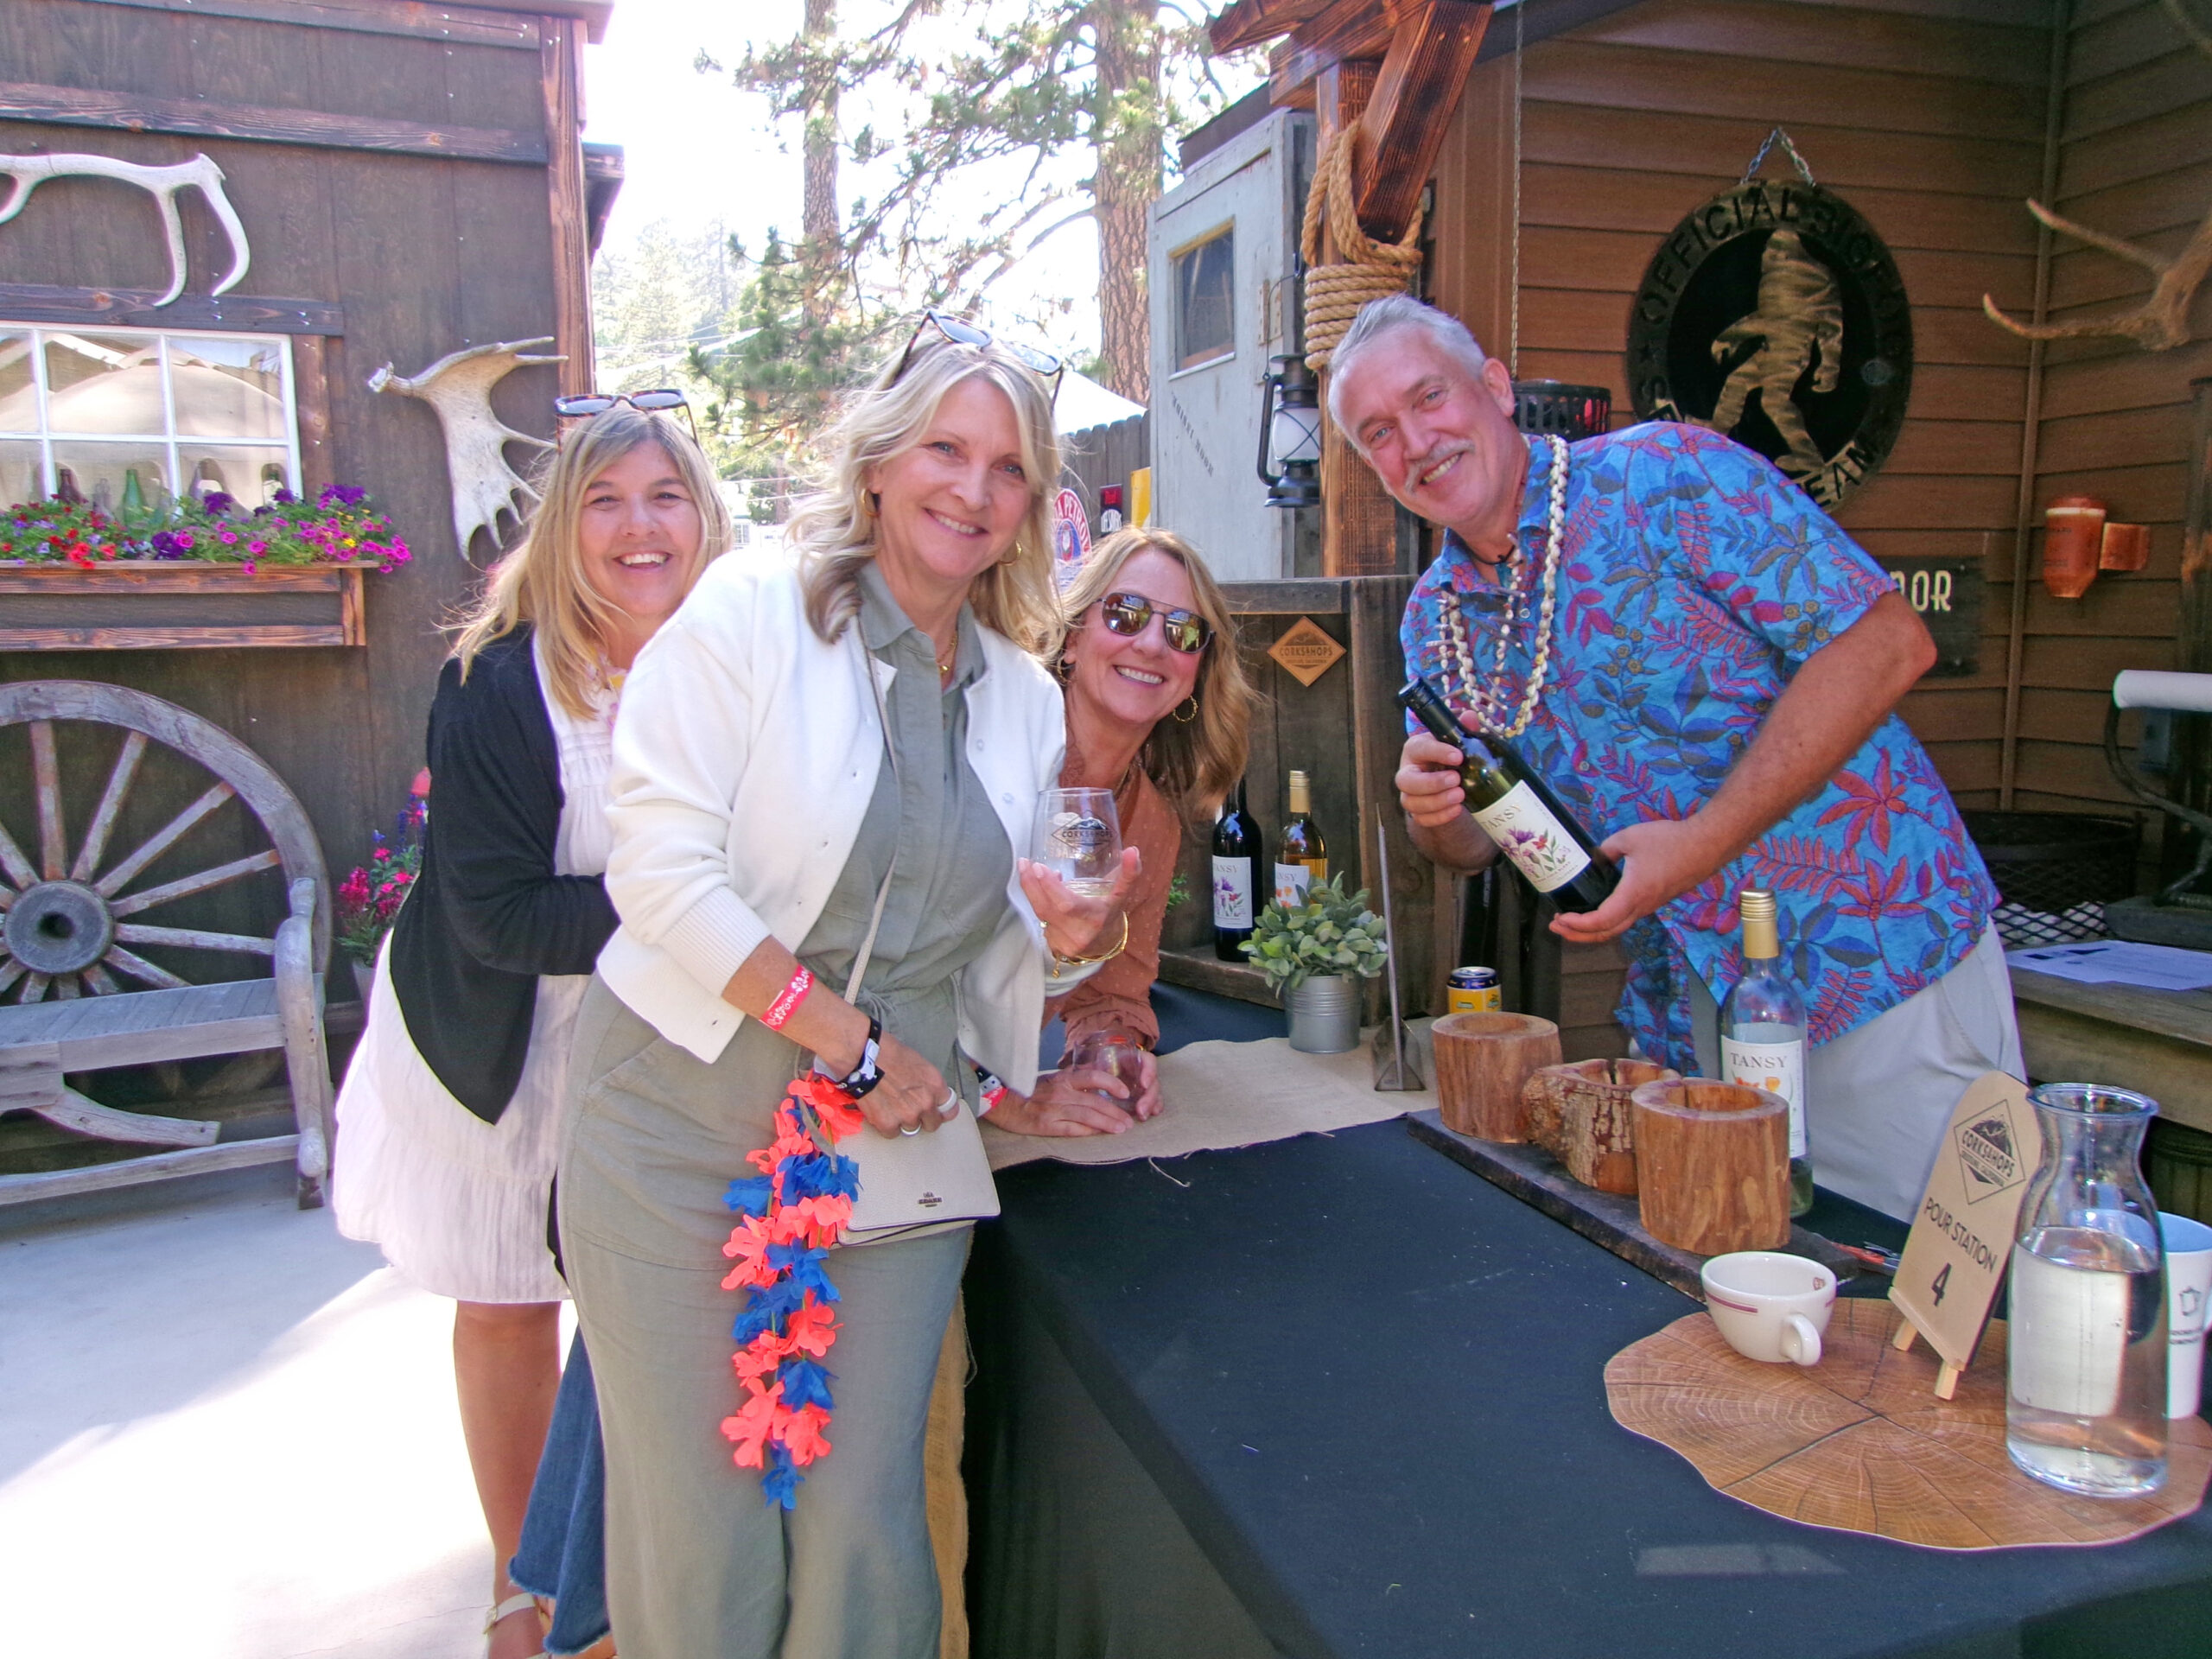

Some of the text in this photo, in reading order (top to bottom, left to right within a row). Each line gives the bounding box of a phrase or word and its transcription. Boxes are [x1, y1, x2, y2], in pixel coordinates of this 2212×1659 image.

[1640, 187, 1800, 326] OFFICIAL
[1808, 444, 1879, 504] EAM
[1478, 804, 1522, 831] TANSY
[1214, 863, 1238, 874] ANSY
[1730, 1052, 1788, 1069] TANSY
[1923, 1197, 1998, 1274] POUR STATION
[1931, 1262, 1952, 1306] 4
